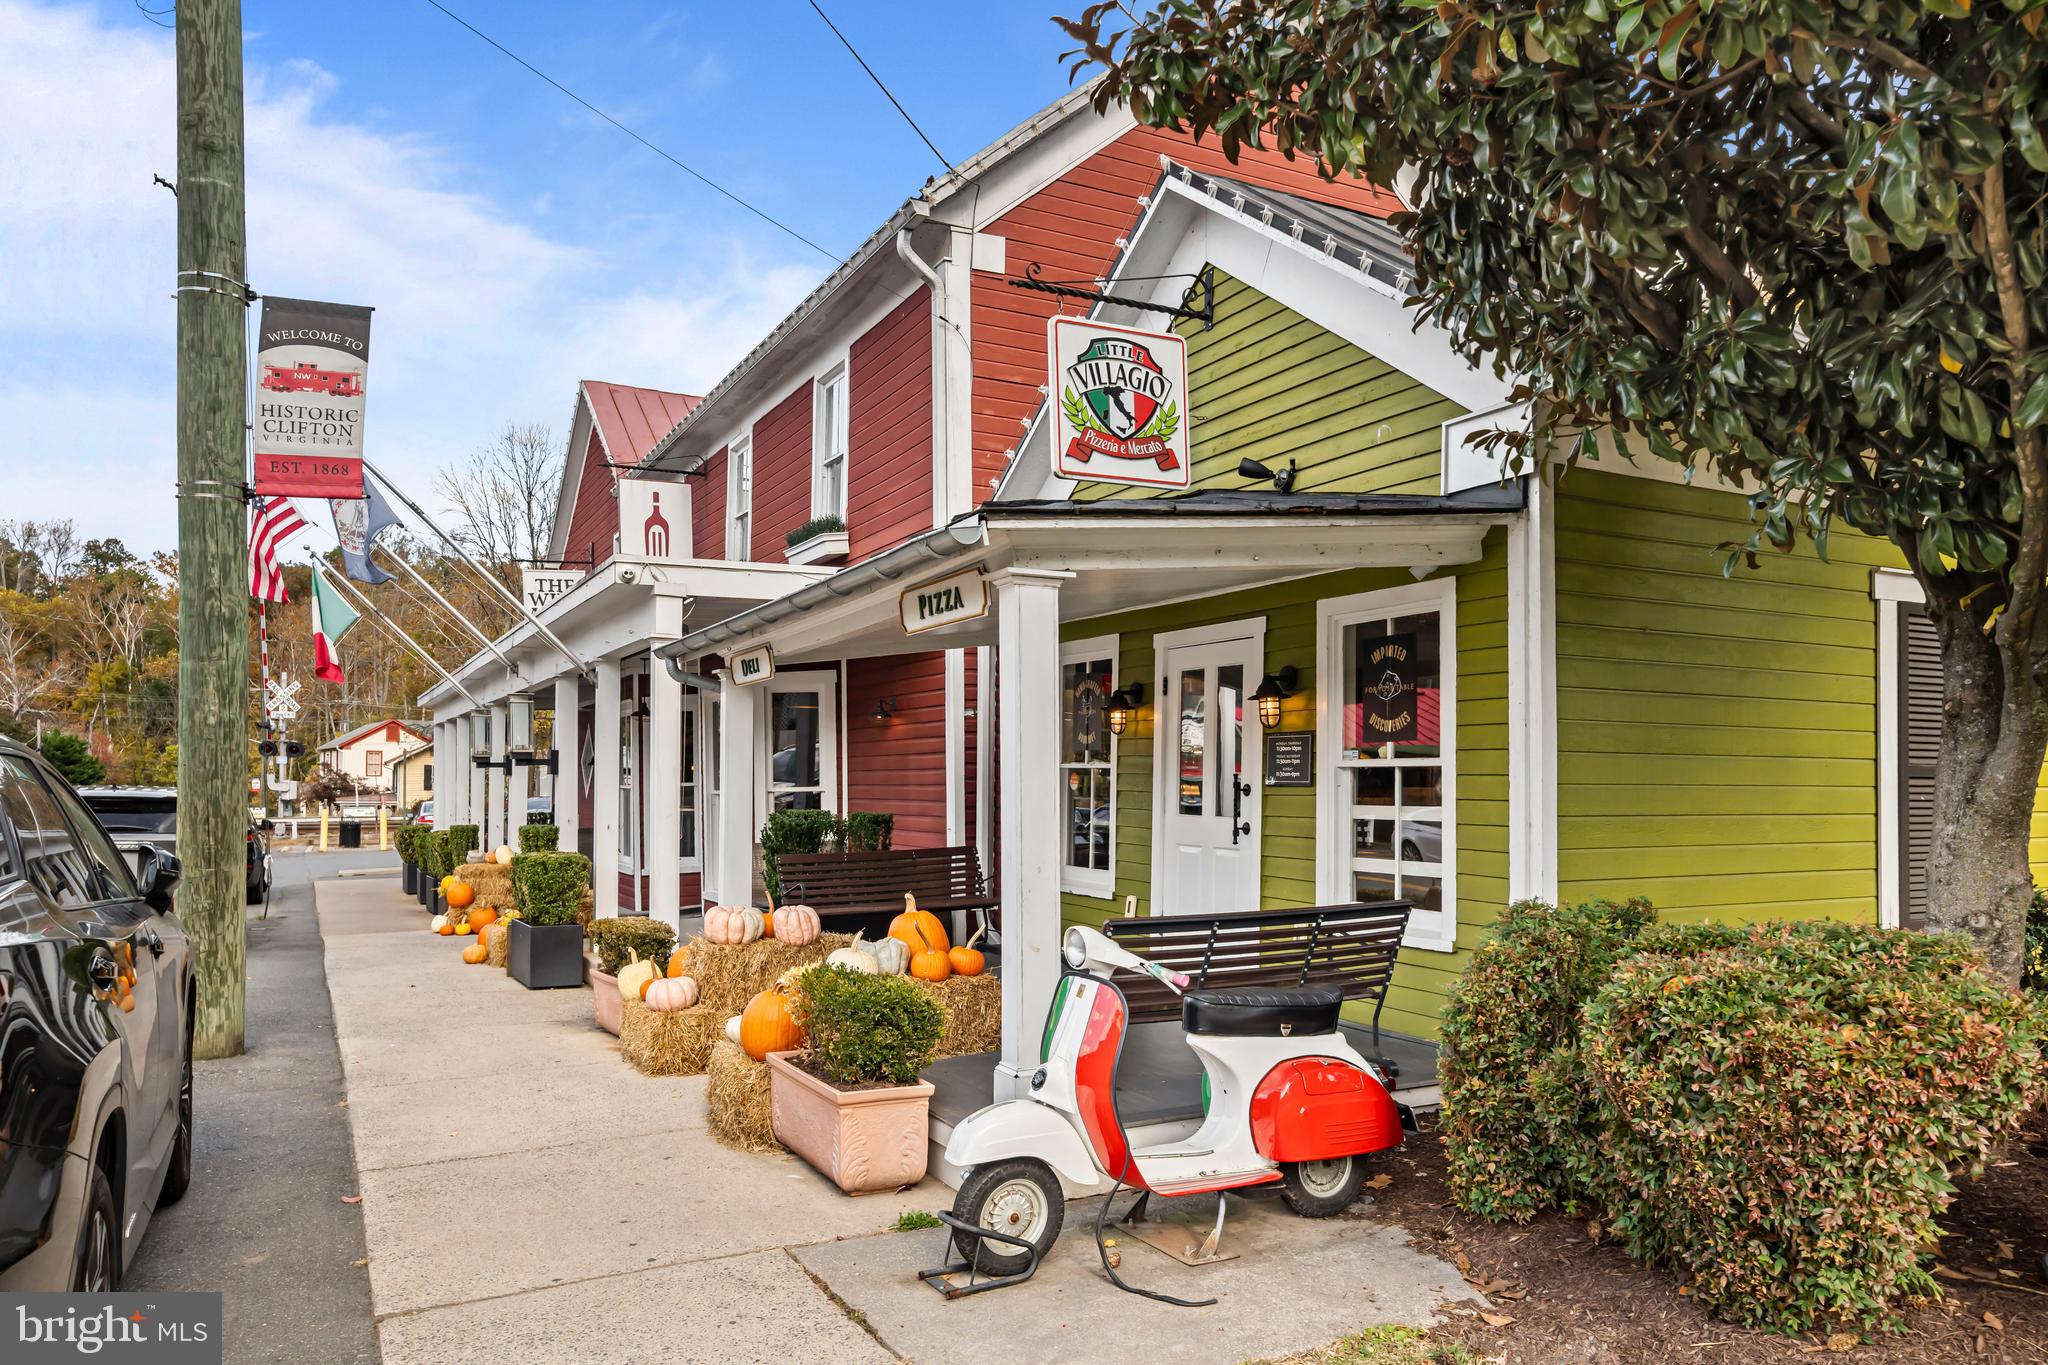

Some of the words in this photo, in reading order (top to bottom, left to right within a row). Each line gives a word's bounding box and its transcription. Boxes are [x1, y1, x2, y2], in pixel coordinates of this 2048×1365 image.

[266, 329, 342, 346] WELCOME
[344, 335, 364, 351] TO
[1096, 343, 1144, 363] LITTLE
[294, 372, 311, 380] NW
[1072, 361, 1166, 399] VILLAGIO
[259, 403, 360, 424] HISTORIC
[263, 420, 354, 438] CLIFTON
[263, 434, 354, 446] VIRGINIA
[1084, 429, 1119, 454] Pizzeria
[1120, 445, 1127, 455] e
[1127, 440, 1164, 456] Mercato
[270, 460, 305, 475] EST.
[312, 463, 350, 477] 1868
[917, 585, 965, 620] PIZZA
[740, 656, 761, 677] DELI
